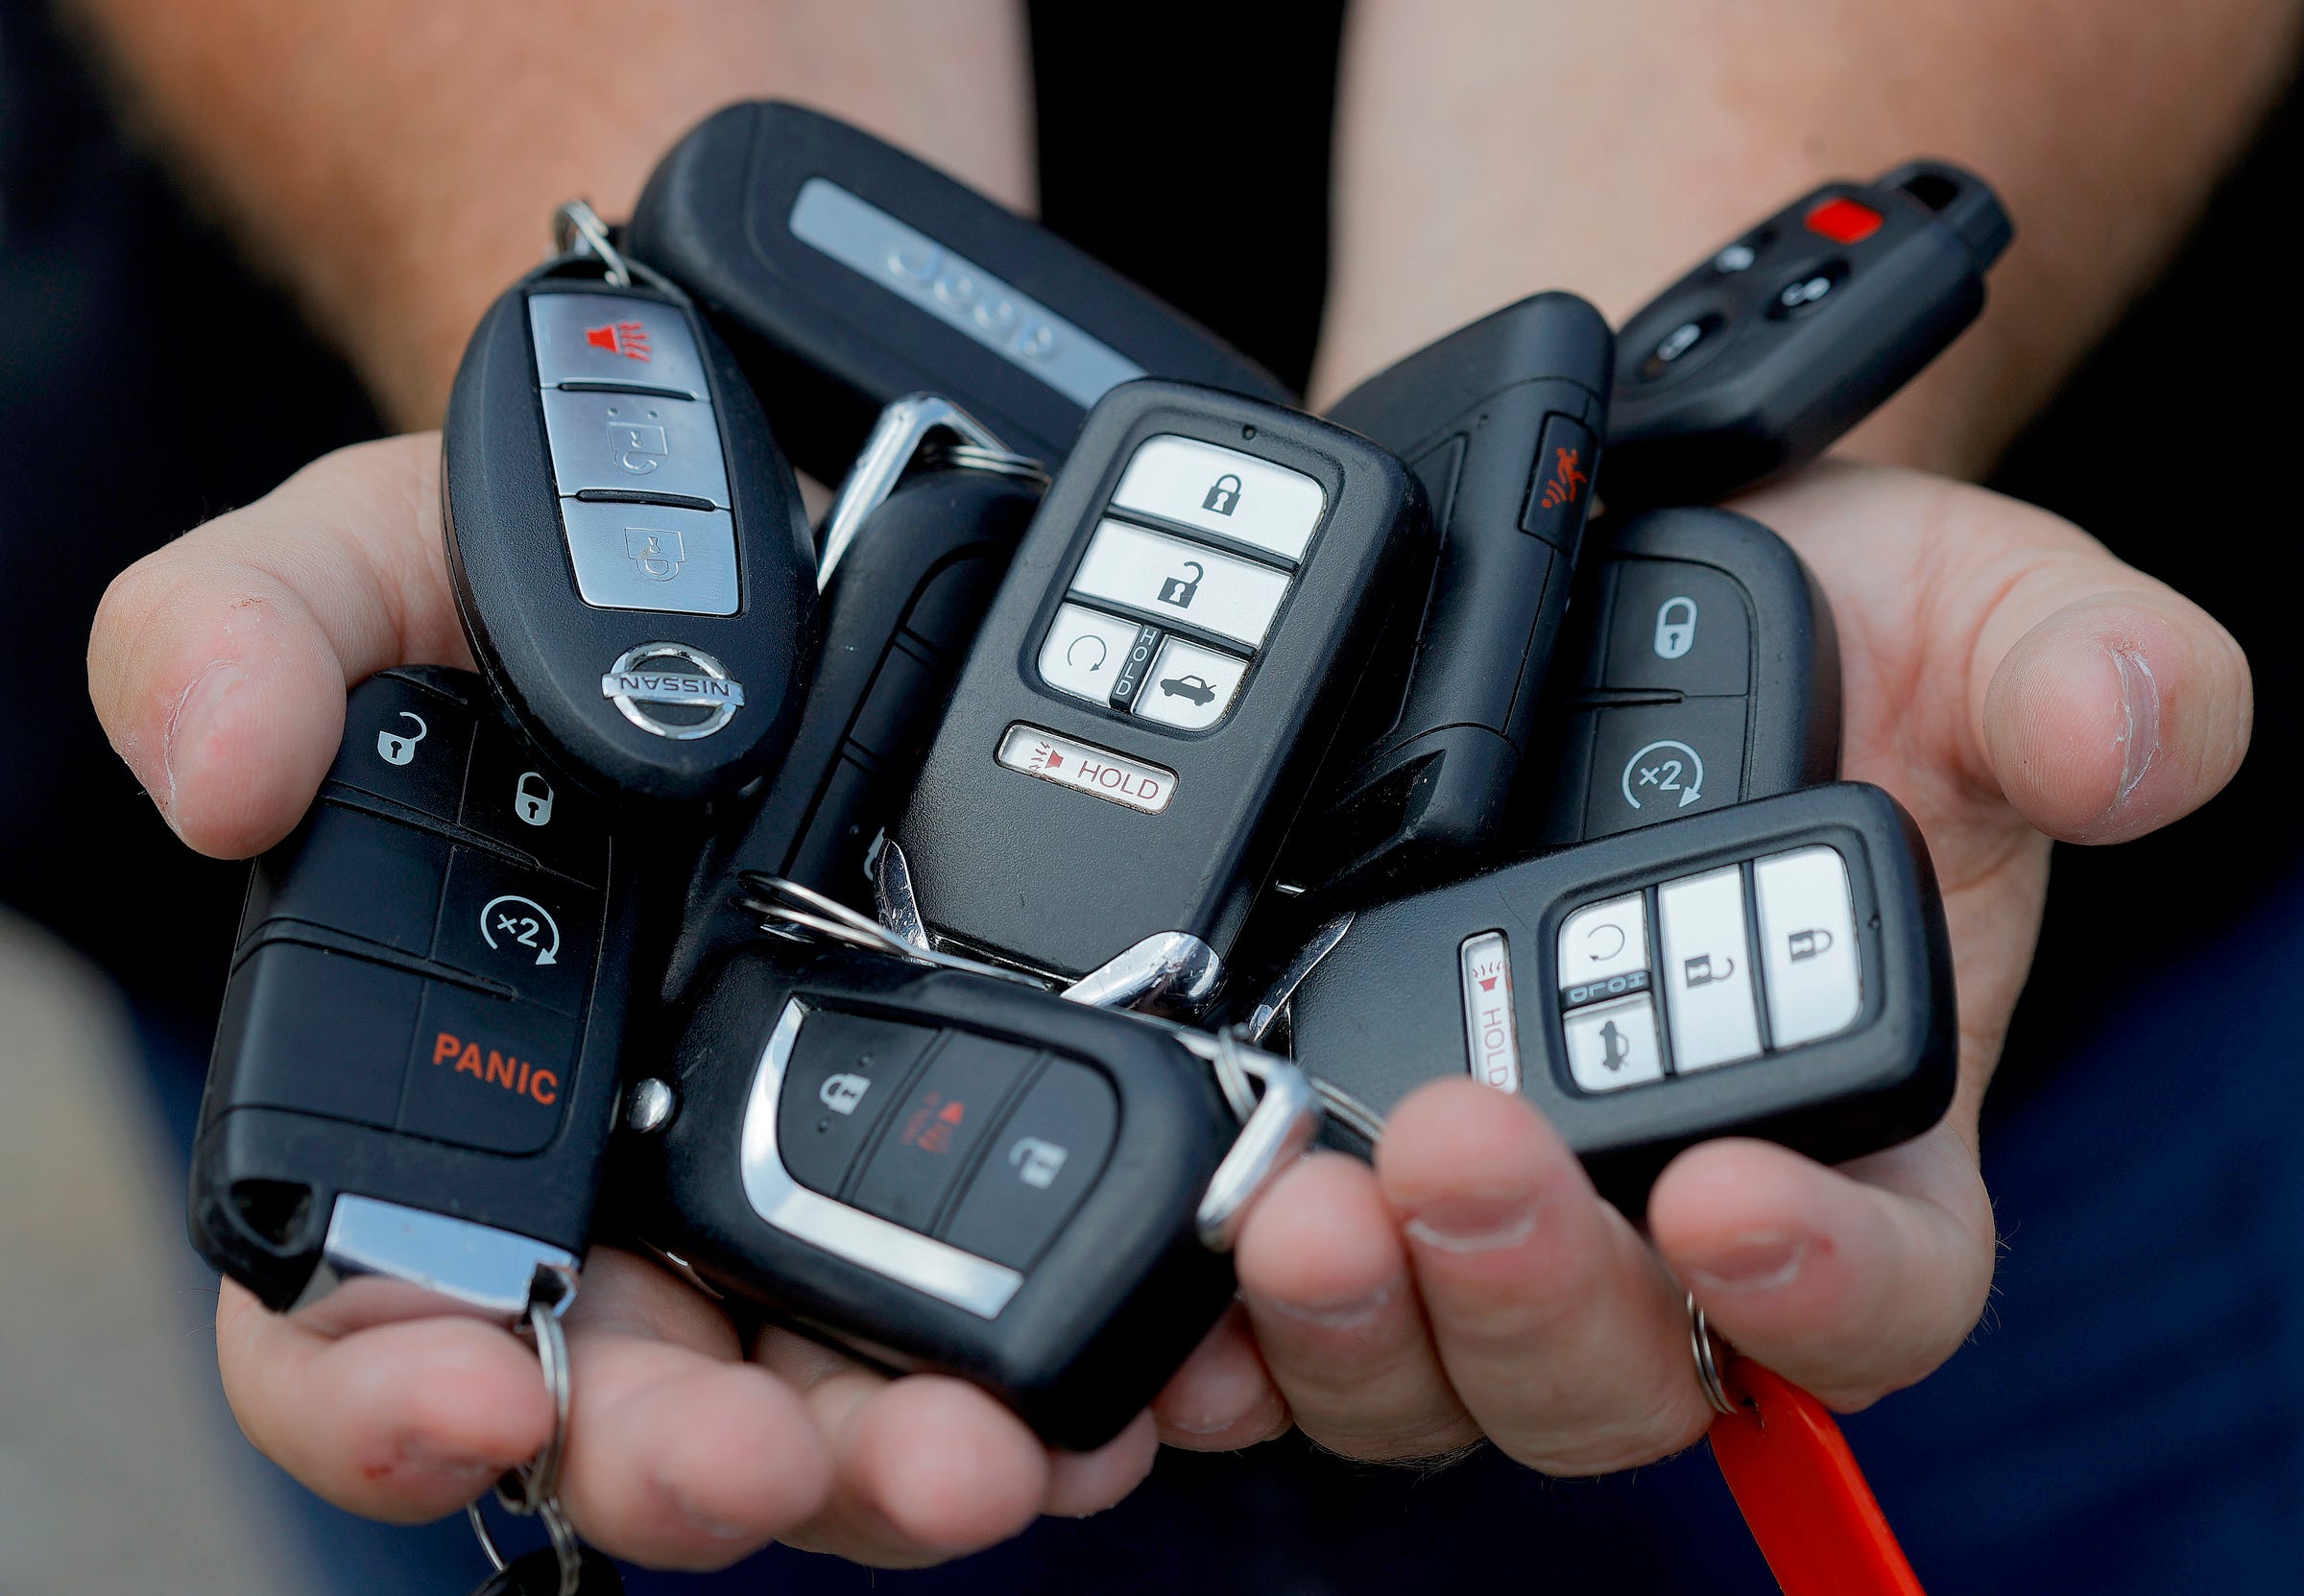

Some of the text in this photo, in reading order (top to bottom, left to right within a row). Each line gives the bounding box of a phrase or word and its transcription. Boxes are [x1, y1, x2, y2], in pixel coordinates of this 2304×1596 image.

[619, 676, 731, 698] NISSAN
[1116, 628, 1158, 696] HOLD
[1076, 759, 1160, 800] HOLD
[1569, 971, 1646, 1003] HOLD
[432, 1031, 559, 1105] PANIC
[1481, 1008, 1510, 1087] HOLD
